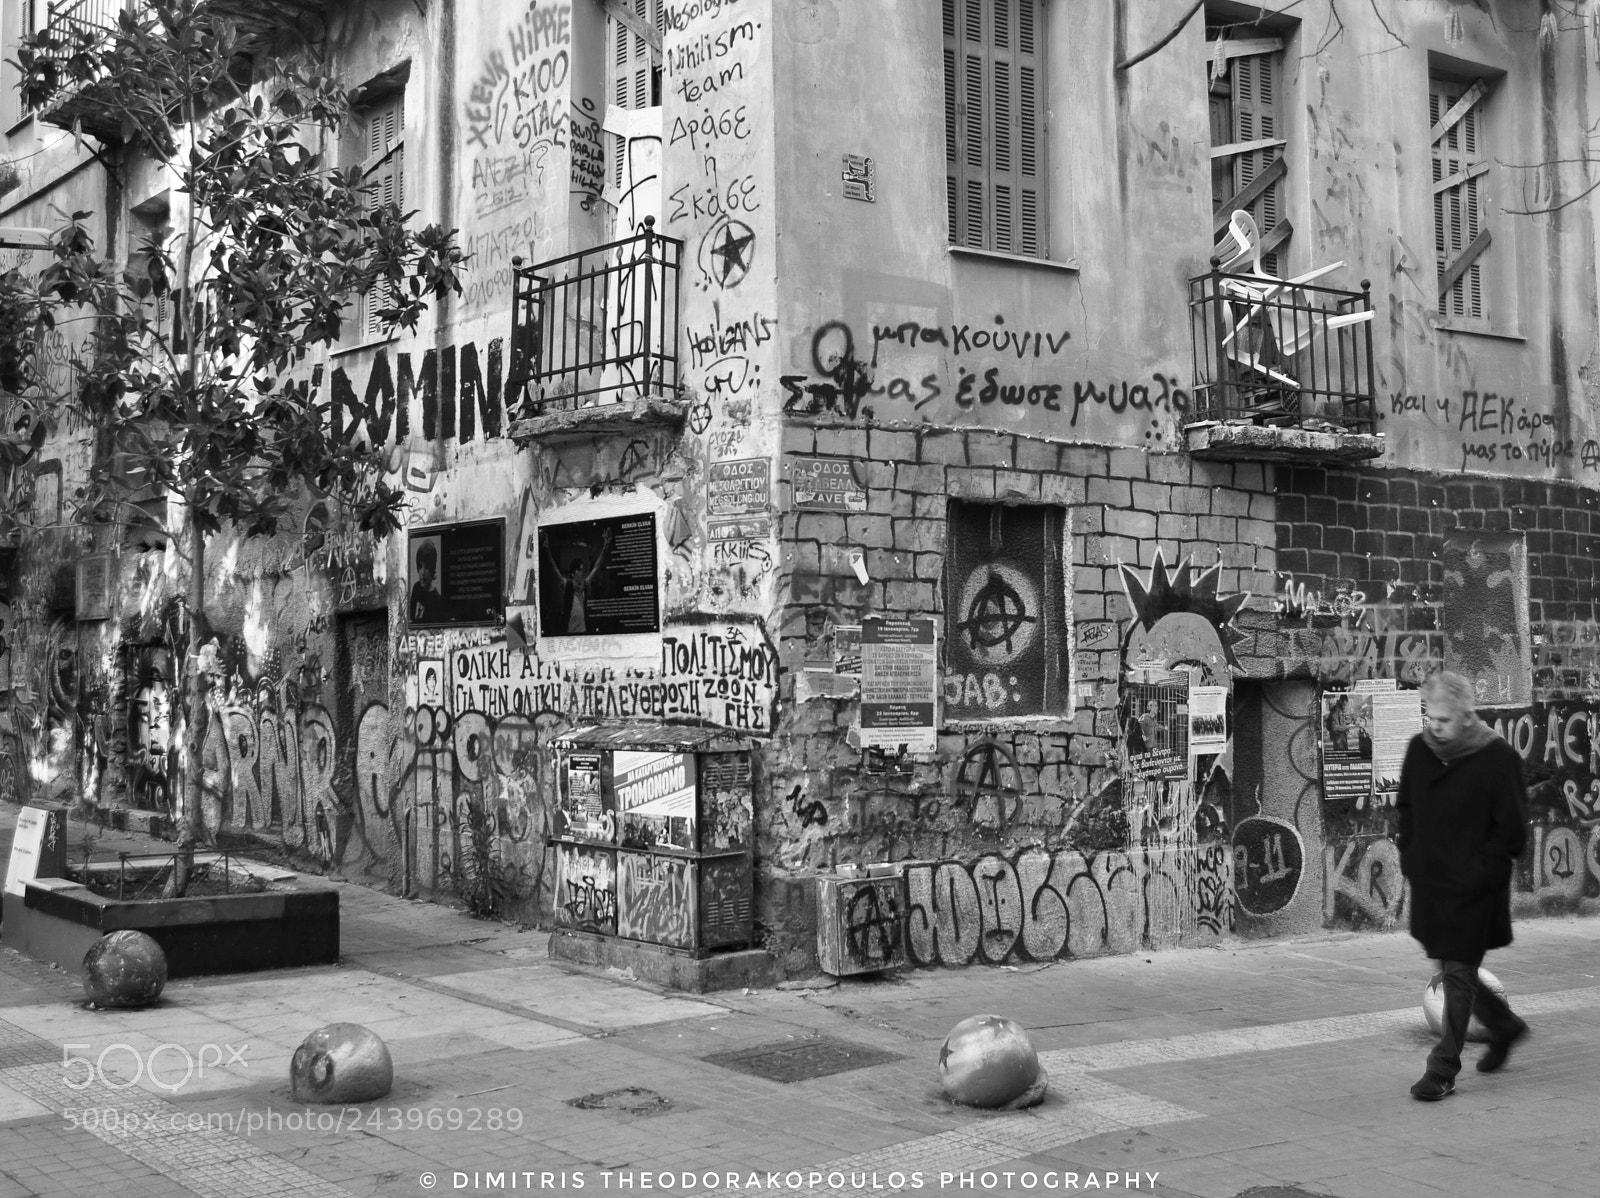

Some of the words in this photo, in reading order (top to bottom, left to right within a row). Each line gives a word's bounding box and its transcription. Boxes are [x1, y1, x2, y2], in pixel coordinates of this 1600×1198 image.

[677, 62, 743, 103] team
[722, 462, 754, 476] ΟΔΟΣ
[812, 461, 850, 476] ΟΔΟΣ
[457, 649, 511, 680] ΟΛΙΚΗ
[661, 632, 775, 689] ΠΟΛΙΤΙΣΜΟΥ
[618, 765, 686, 812] ΤΡΟΜΟΝΟΜΟ
